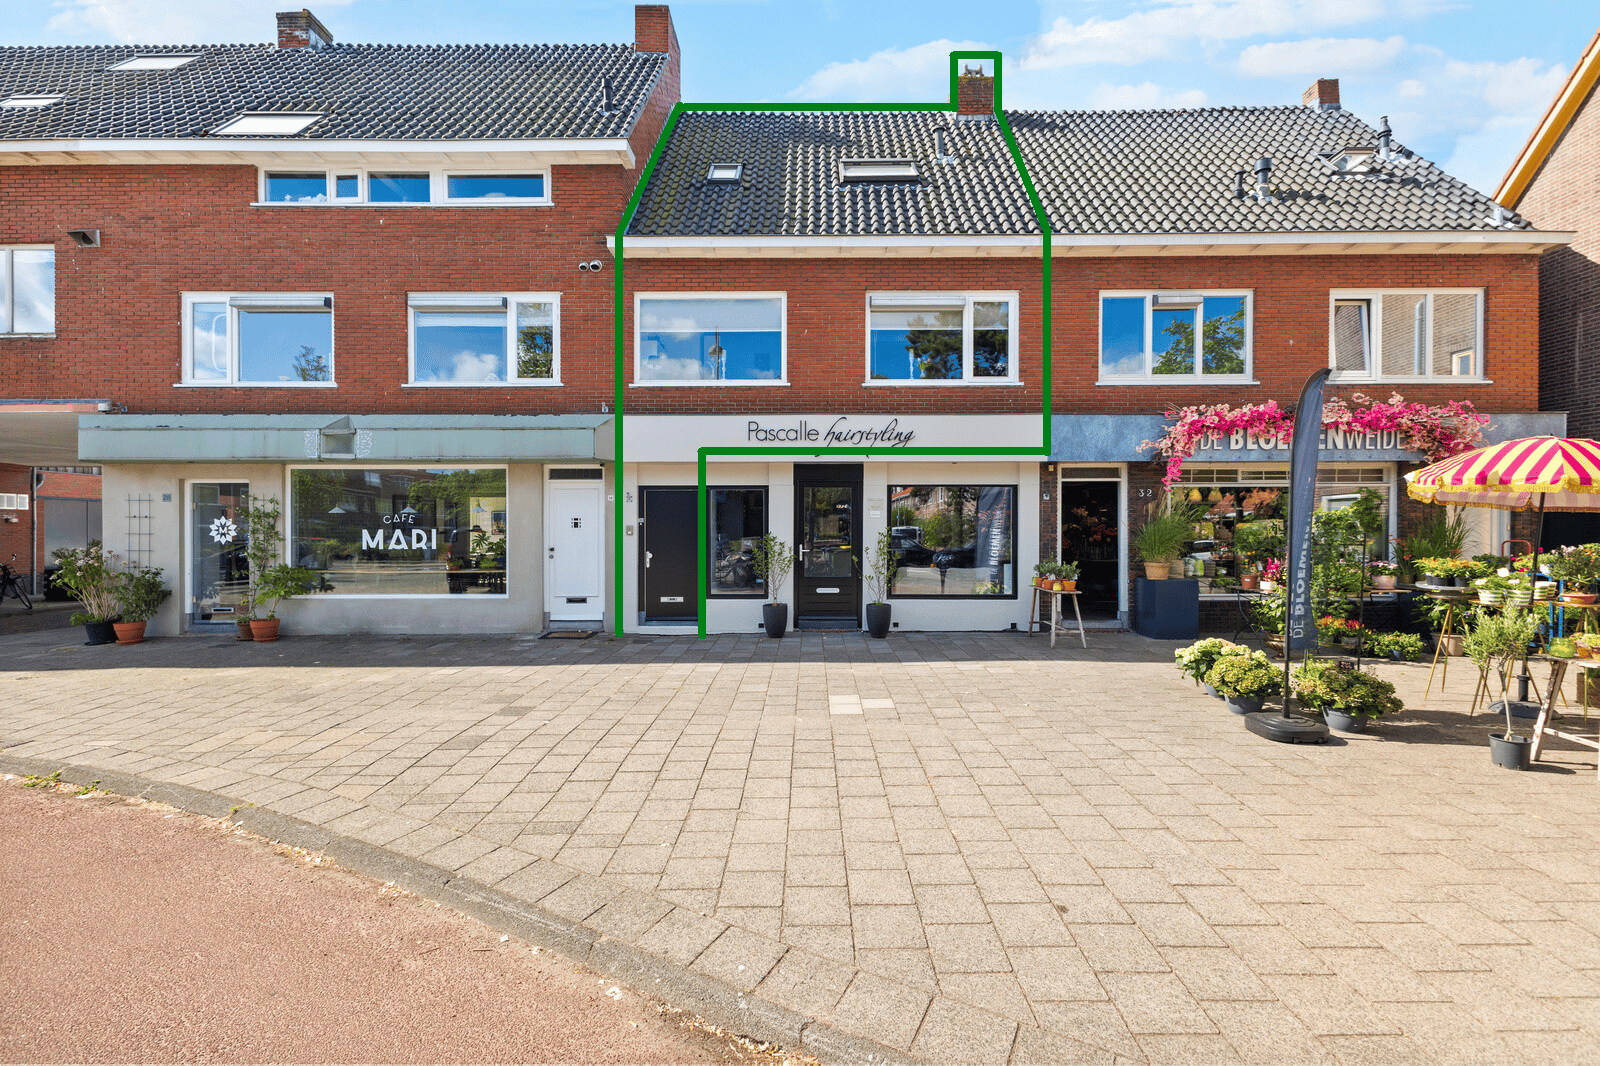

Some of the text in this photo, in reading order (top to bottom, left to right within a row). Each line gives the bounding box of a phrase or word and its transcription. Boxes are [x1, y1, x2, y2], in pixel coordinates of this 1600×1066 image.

[748, 416, 916, 458] Pascalle hairstyling
[1229, 427, 1406, 450] BLOEENWEIDE
[1138, 488, 1153, 497] 32
[383, 513, 416, 524] CAFE
[219, 526, 228, 534] M
[362, 528, 437, 550] MARI
[1293, 620, 1305, 639] DE
